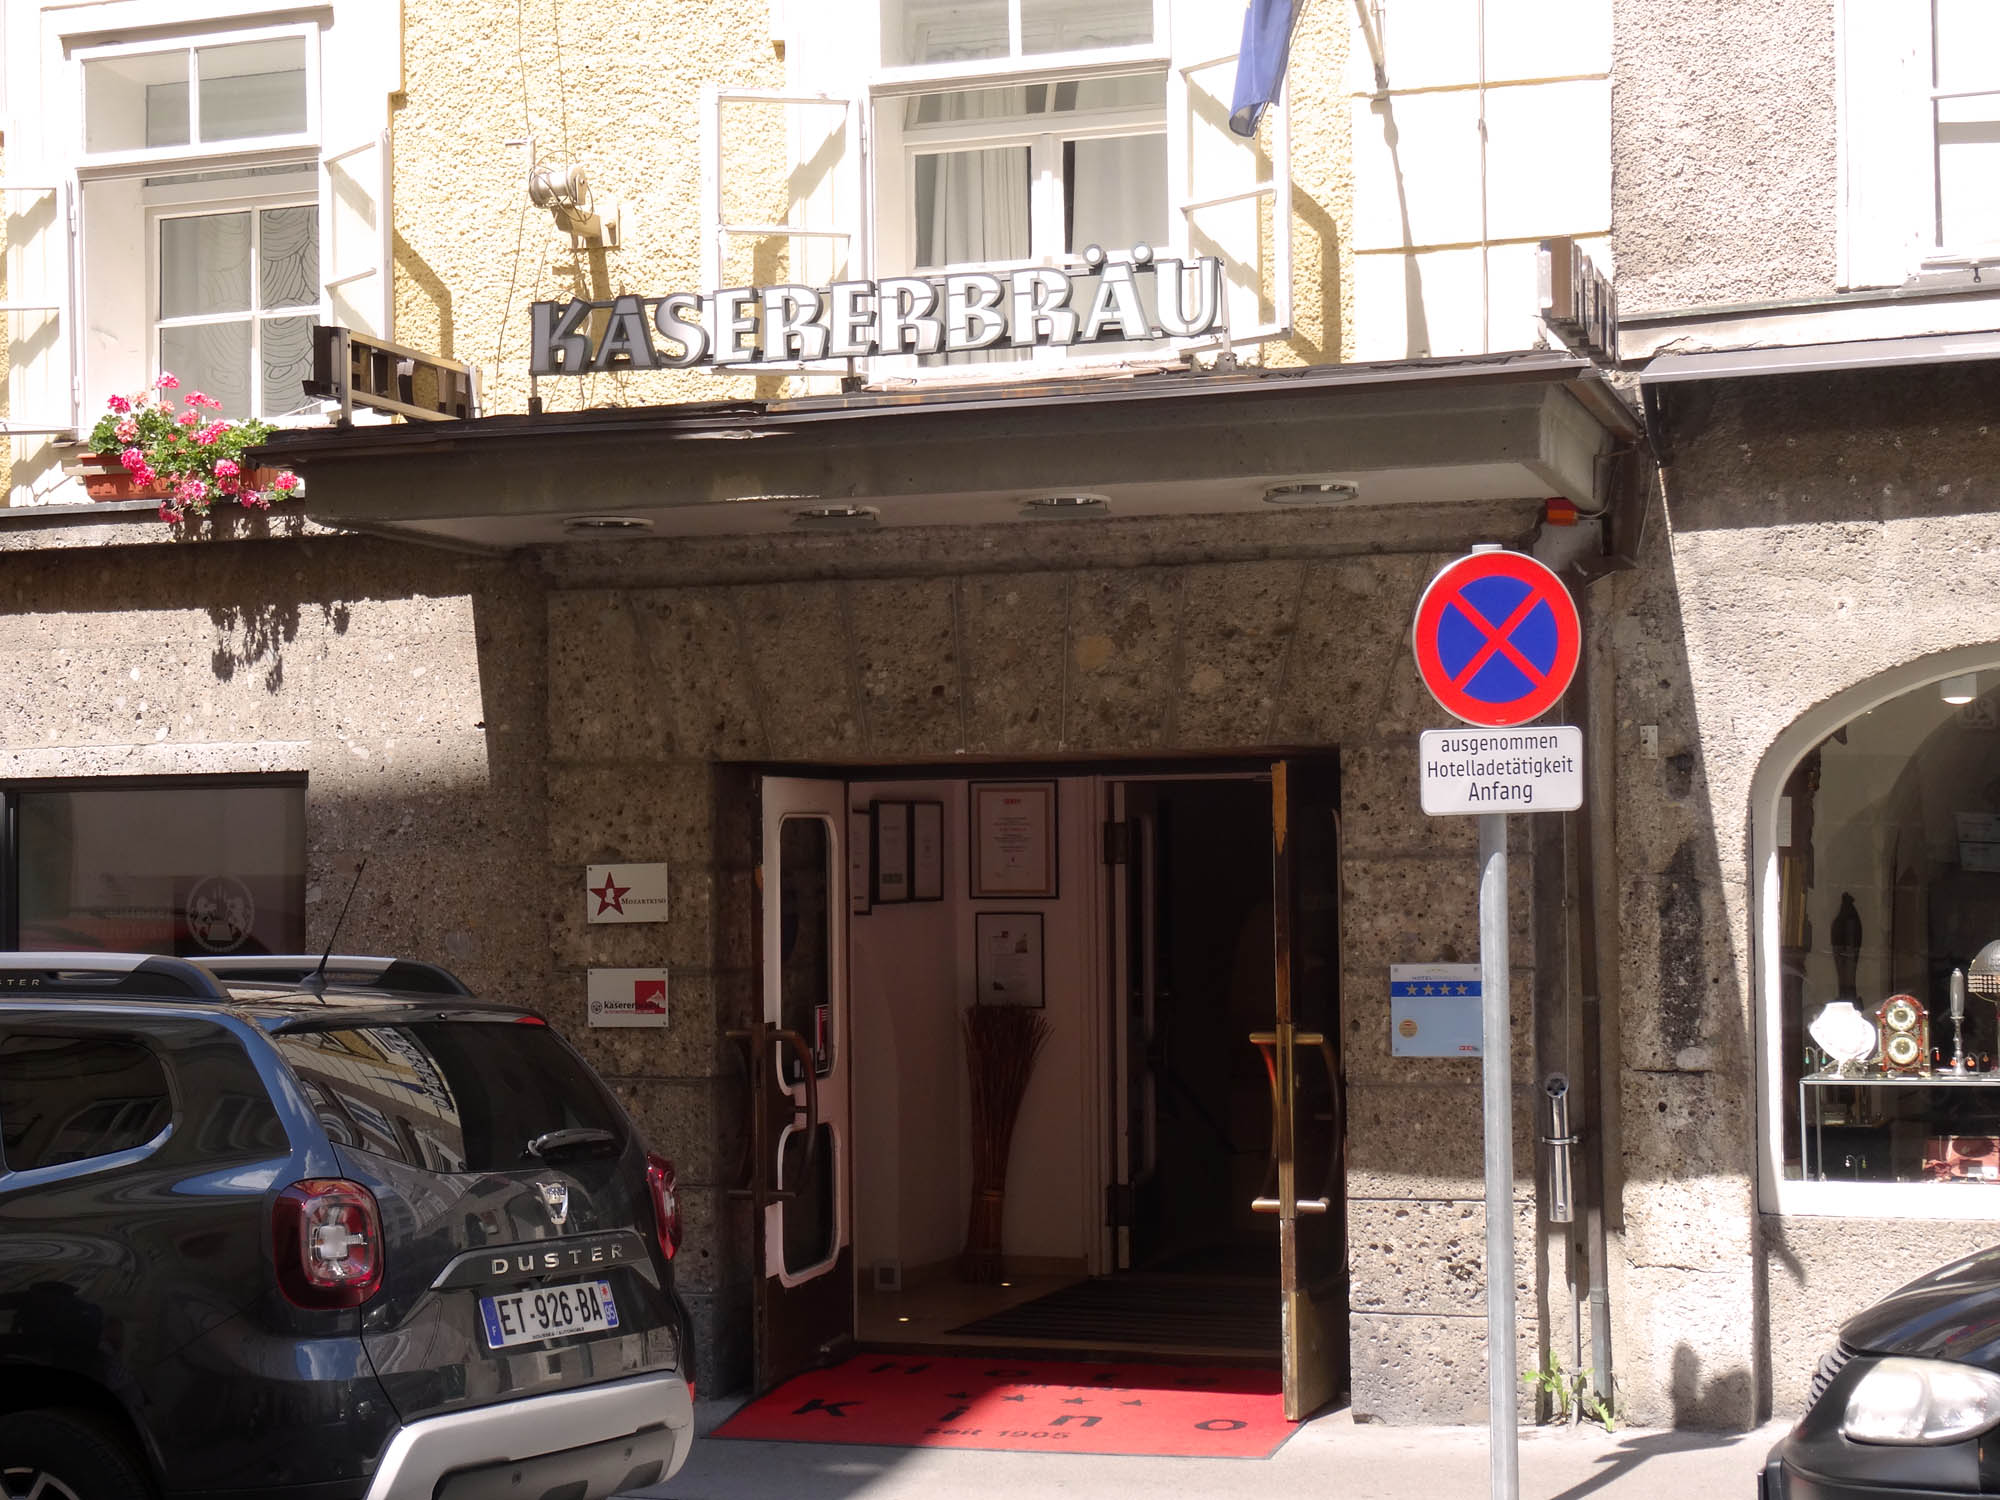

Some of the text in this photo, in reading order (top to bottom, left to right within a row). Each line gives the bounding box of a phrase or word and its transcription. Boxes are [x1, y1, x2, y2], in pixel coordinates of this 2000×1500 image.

[530, 243, 1223, 375] KASERERBRÄU
[1441, 735, 1558, 755] ausgenommen
[1427, 755, 1574, 778] Hotelladetätigkeit
[1468, 781, 1533, 803] Anfang
[491, 1245, 624, 1275] DUSTER
[497, 1287, 602, 1336] ET-926-BA
[605, 1304, 616, 1320] 95
[998, 1430, 1071, 1439] 1905
